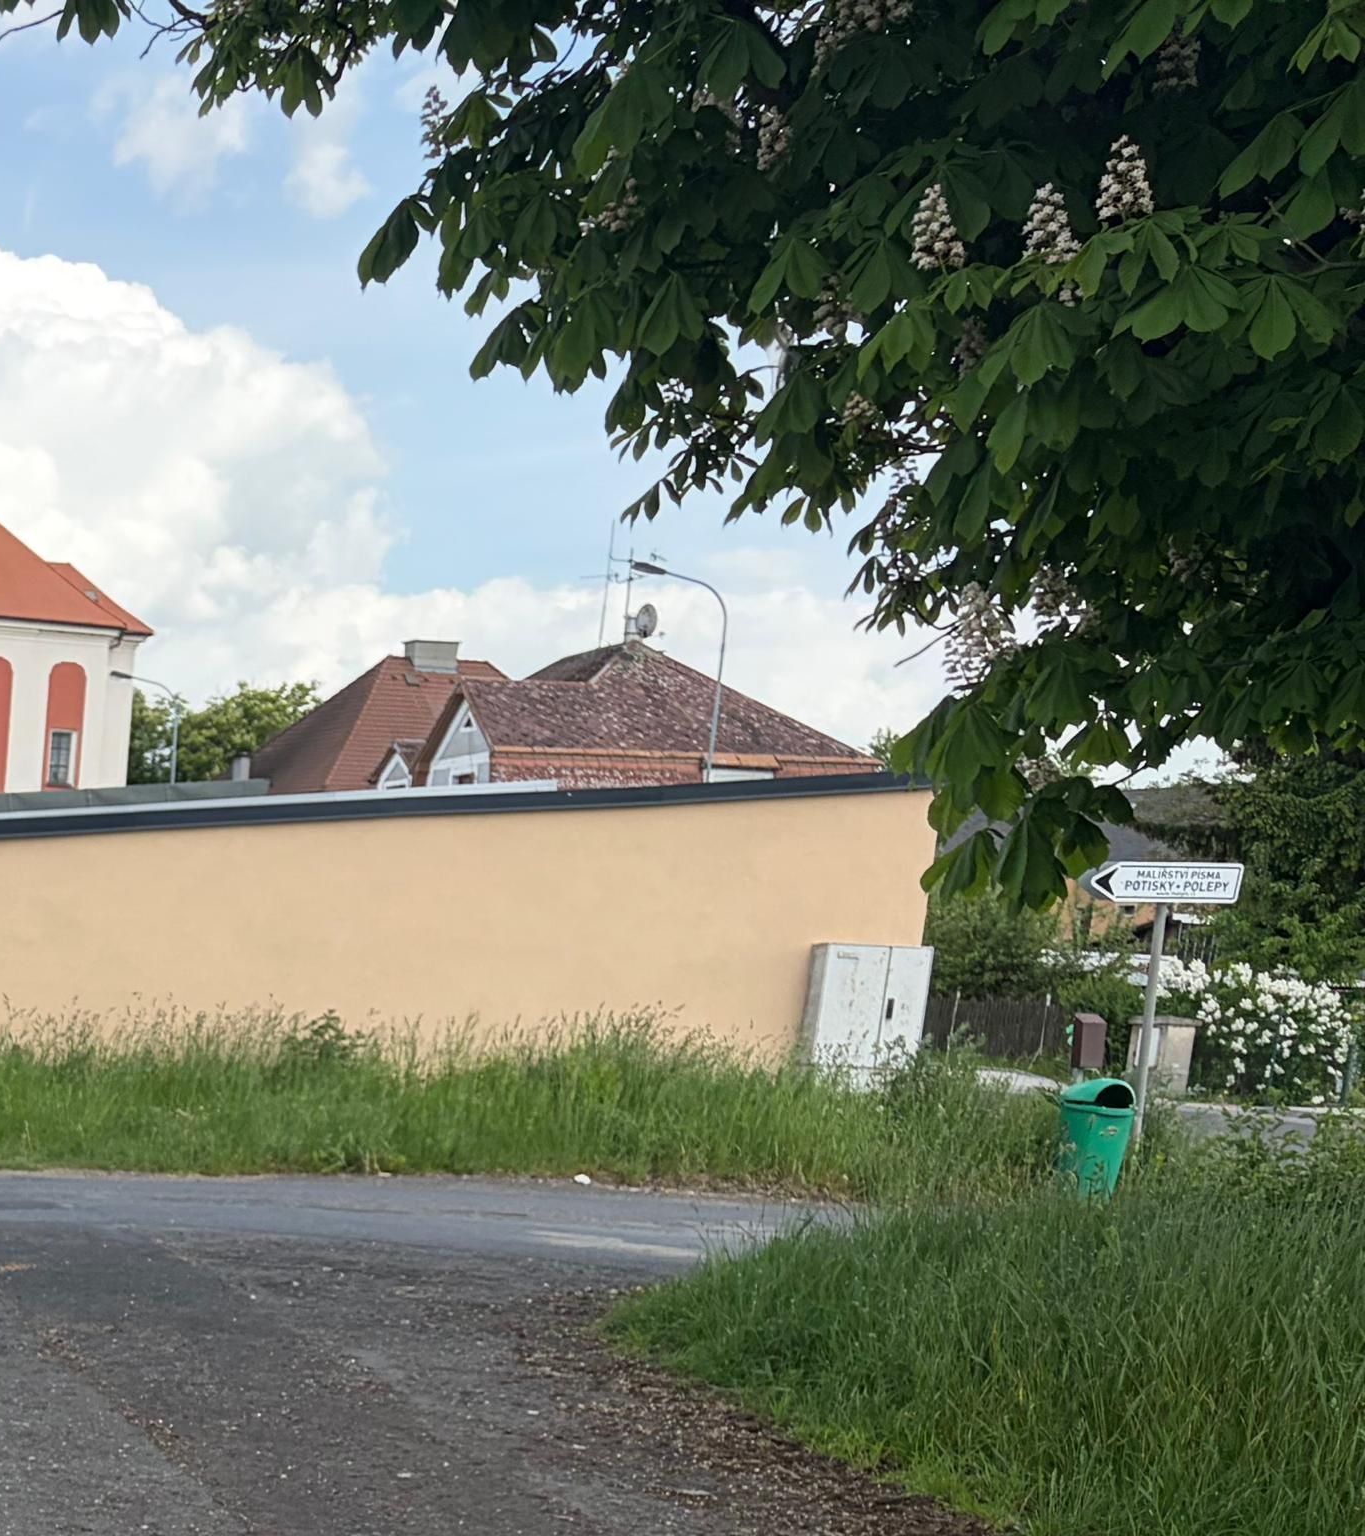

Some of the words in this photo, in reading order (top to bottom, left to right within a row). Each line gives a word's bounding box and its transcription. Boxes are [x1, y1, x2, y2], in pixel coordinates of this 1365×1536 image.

[1136, 868, 1189, 879] MALÍŘSTVÍ
[1191, 869, 1221, 880] PÍSMA
[1124, 880, 1175, 891] POTISKY
[1183, 881, 1230, 892] POLEPY
